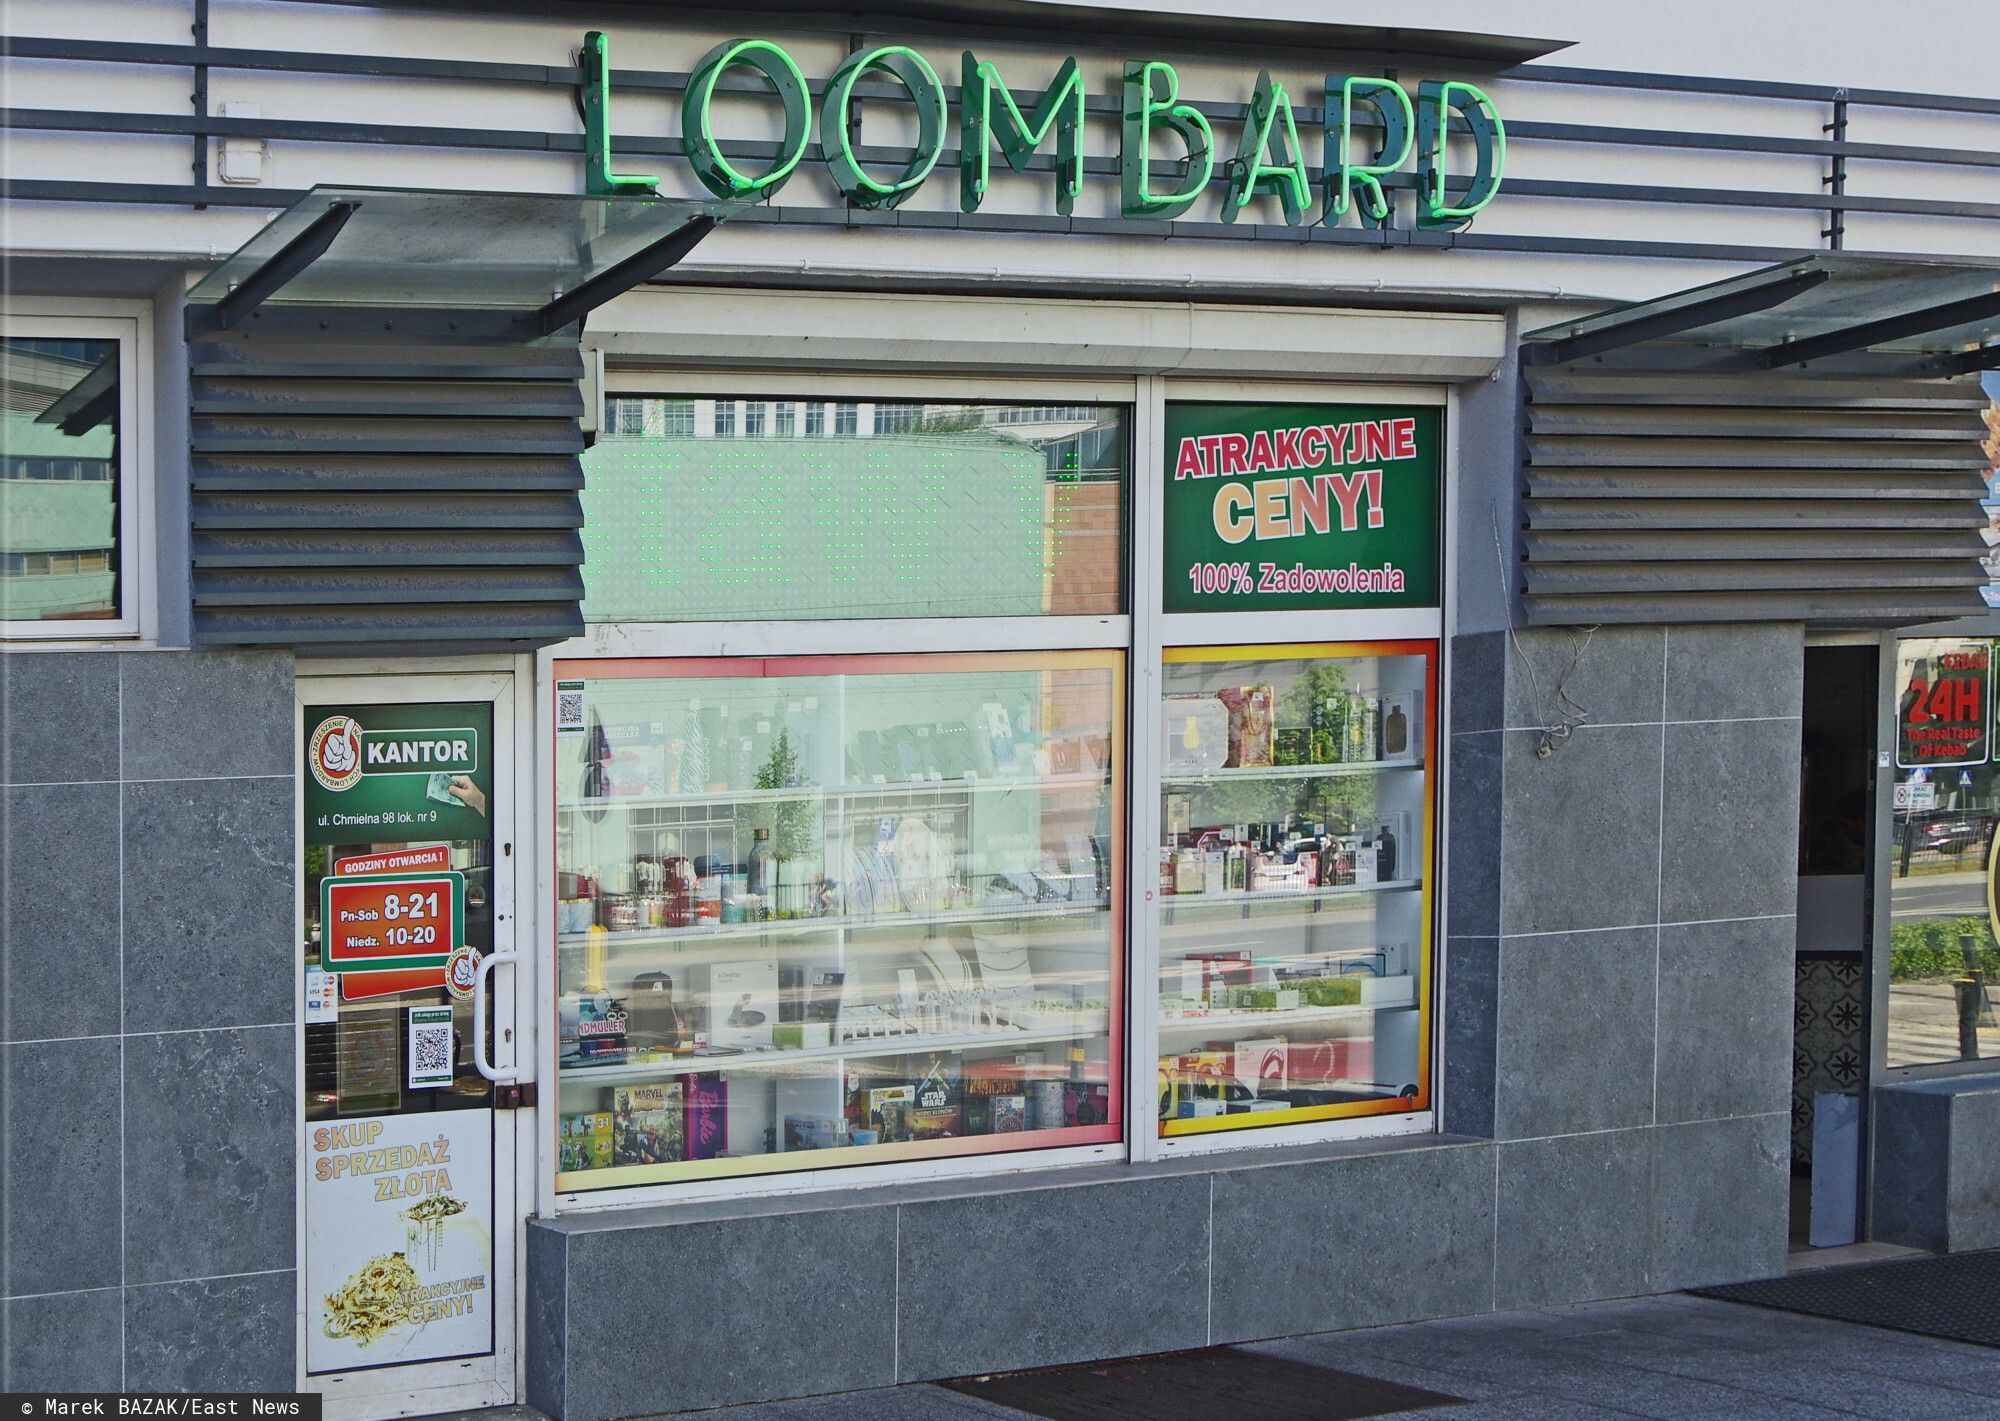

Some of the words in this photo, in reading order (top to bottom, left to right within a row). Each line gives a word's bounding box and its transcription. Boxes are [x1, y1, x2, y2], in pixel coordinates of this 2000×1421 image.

[584, 30, 1507, 232] LOOMBARD
[1174, 418, 1417, 480] ATRAKCYJNE
[1212, 469, 1385, 544] CENY!
[1189, 562, 1253, 594] 100%
[1257, 562, 1405, 594] Zadowolenia
[1908, 677, 1982, 724] 24H
[312, 719, 344, 755] ZRZESZENIE
[1951, 726, 1981, 740] Taste
[367, 740, 469, 764] KANTOR
[318, 814, 329, 827] ul.
[333, 812, 379, 826] Chmielna
[382, 812, 395, 824] 98
[397, 812, 415, 823] lok.
[418, 813, 428, 822] nr
[430, 811, 437, 821] 9
[345, 861, 387, 874] GODZINY
[389, 854, 436, 868] OTWARCIA
[340, 909, 379, 922] Pn-Sob
[384, 892, 438, 920] 8-21
[346, 937, 380, 948] Niedz.
[386, 926, 436, 945] 10-20
[634, 1088, 663, 1100] MARVEL
[921, 1097, 947, 1108] WARS
[924, 1090, 946, 1100] STAR
[313, 1120, 383, 1152] SKUP
[315, 1134, 451, 1182] SPRZEDAŻ
[374, 1168, 452, 1202] ZŁOTA
[394, 1275, 486, 1307] ATRAKCYJNE
[407, 1294, 474, 1325] CENY!
